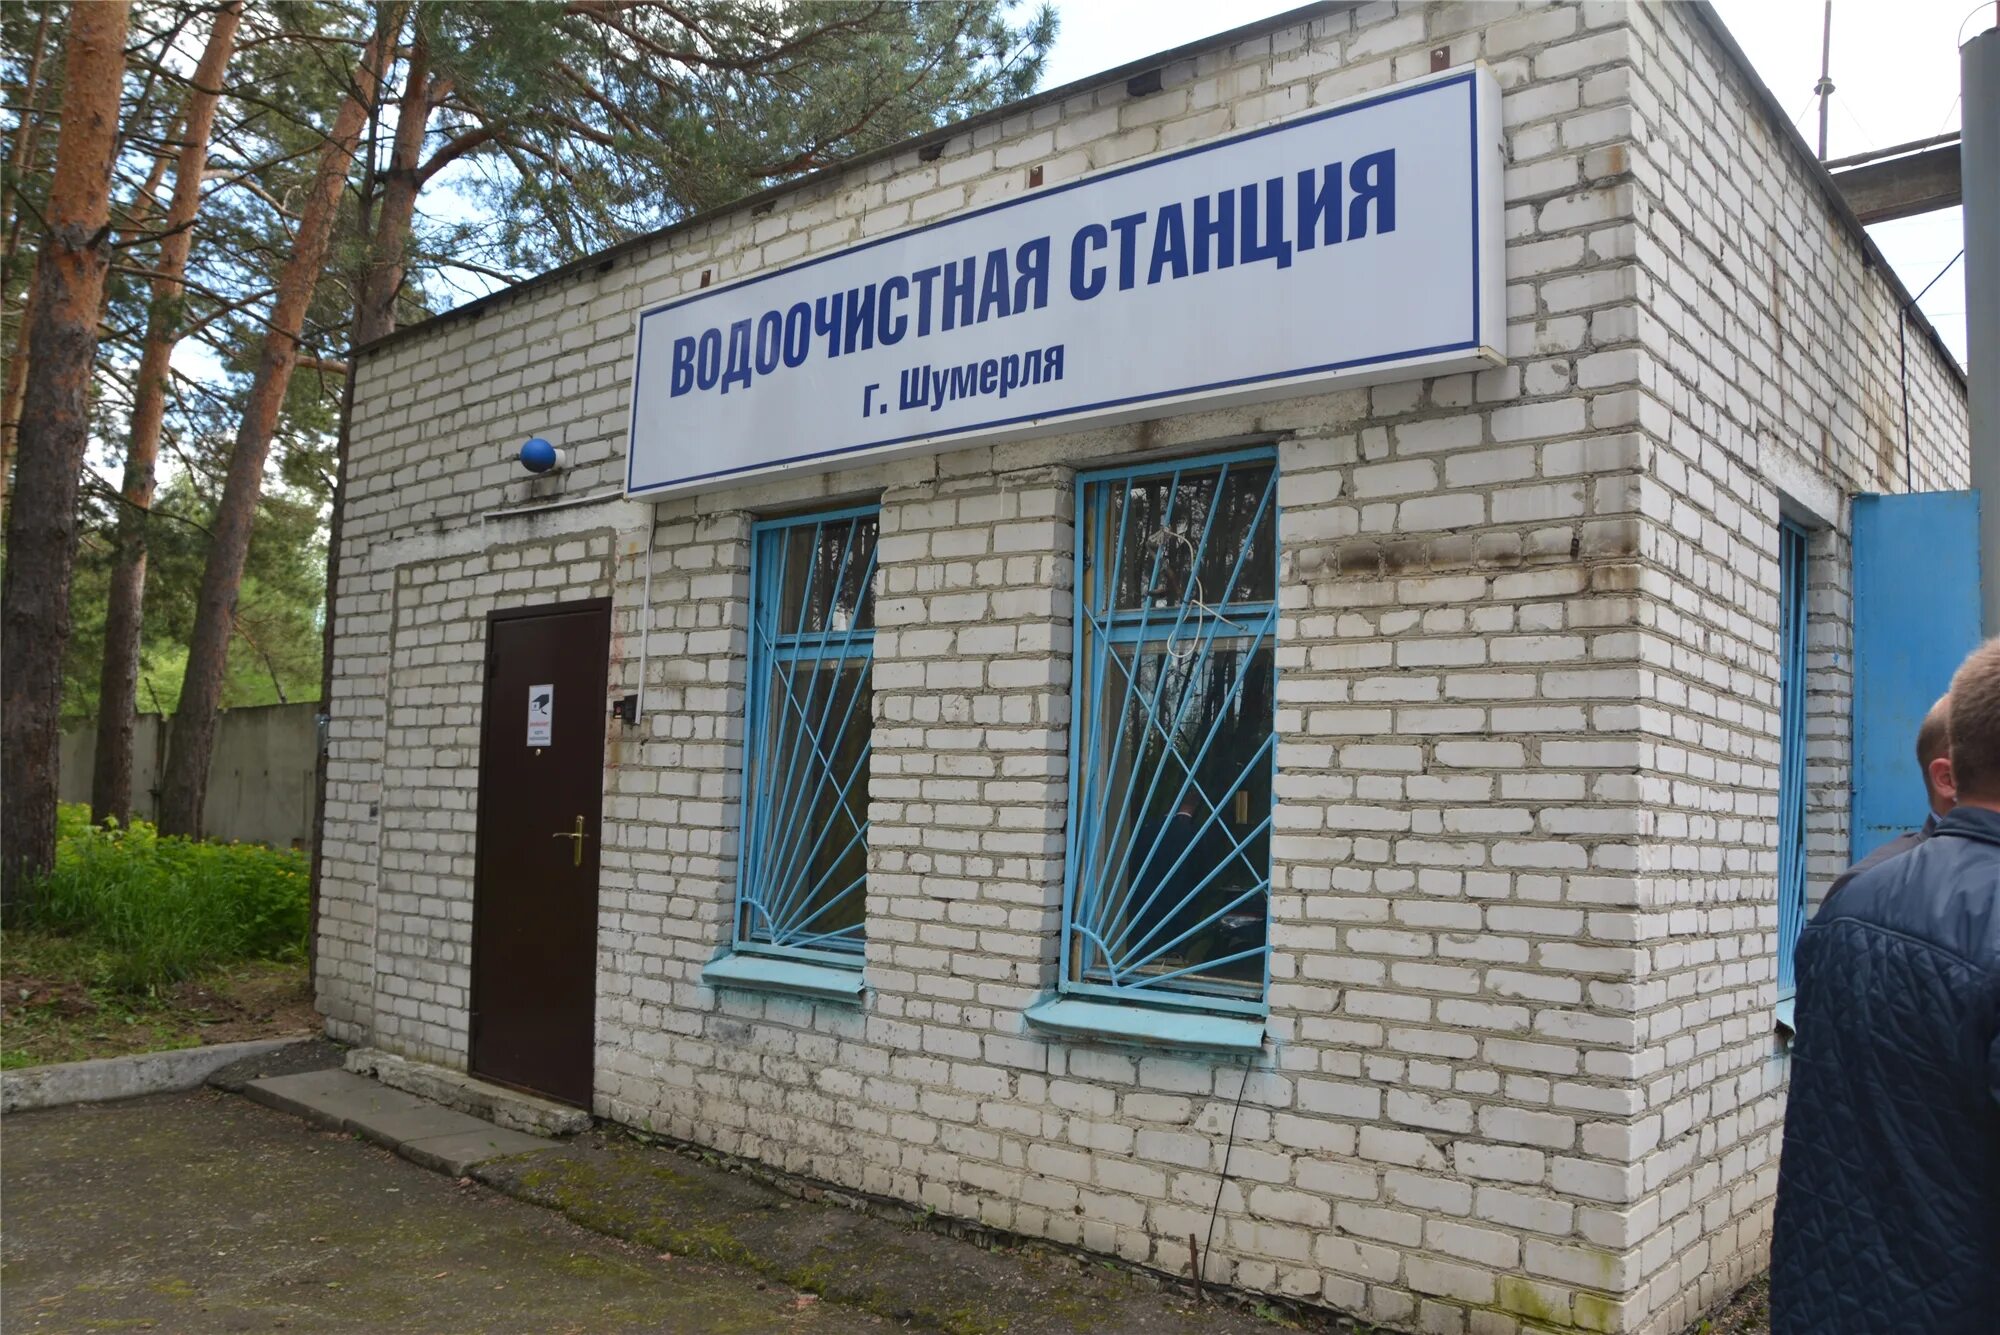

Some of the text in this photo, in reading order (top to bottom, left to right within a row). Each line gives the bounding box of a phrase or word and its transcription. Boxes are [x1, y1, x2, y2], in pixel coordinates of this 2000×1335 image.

[670, 148, 1396, 398] ВОДООЧИСТНАЯ СТАНЦИЯ
[863, 344, 1064, 418] г. Шумерля
